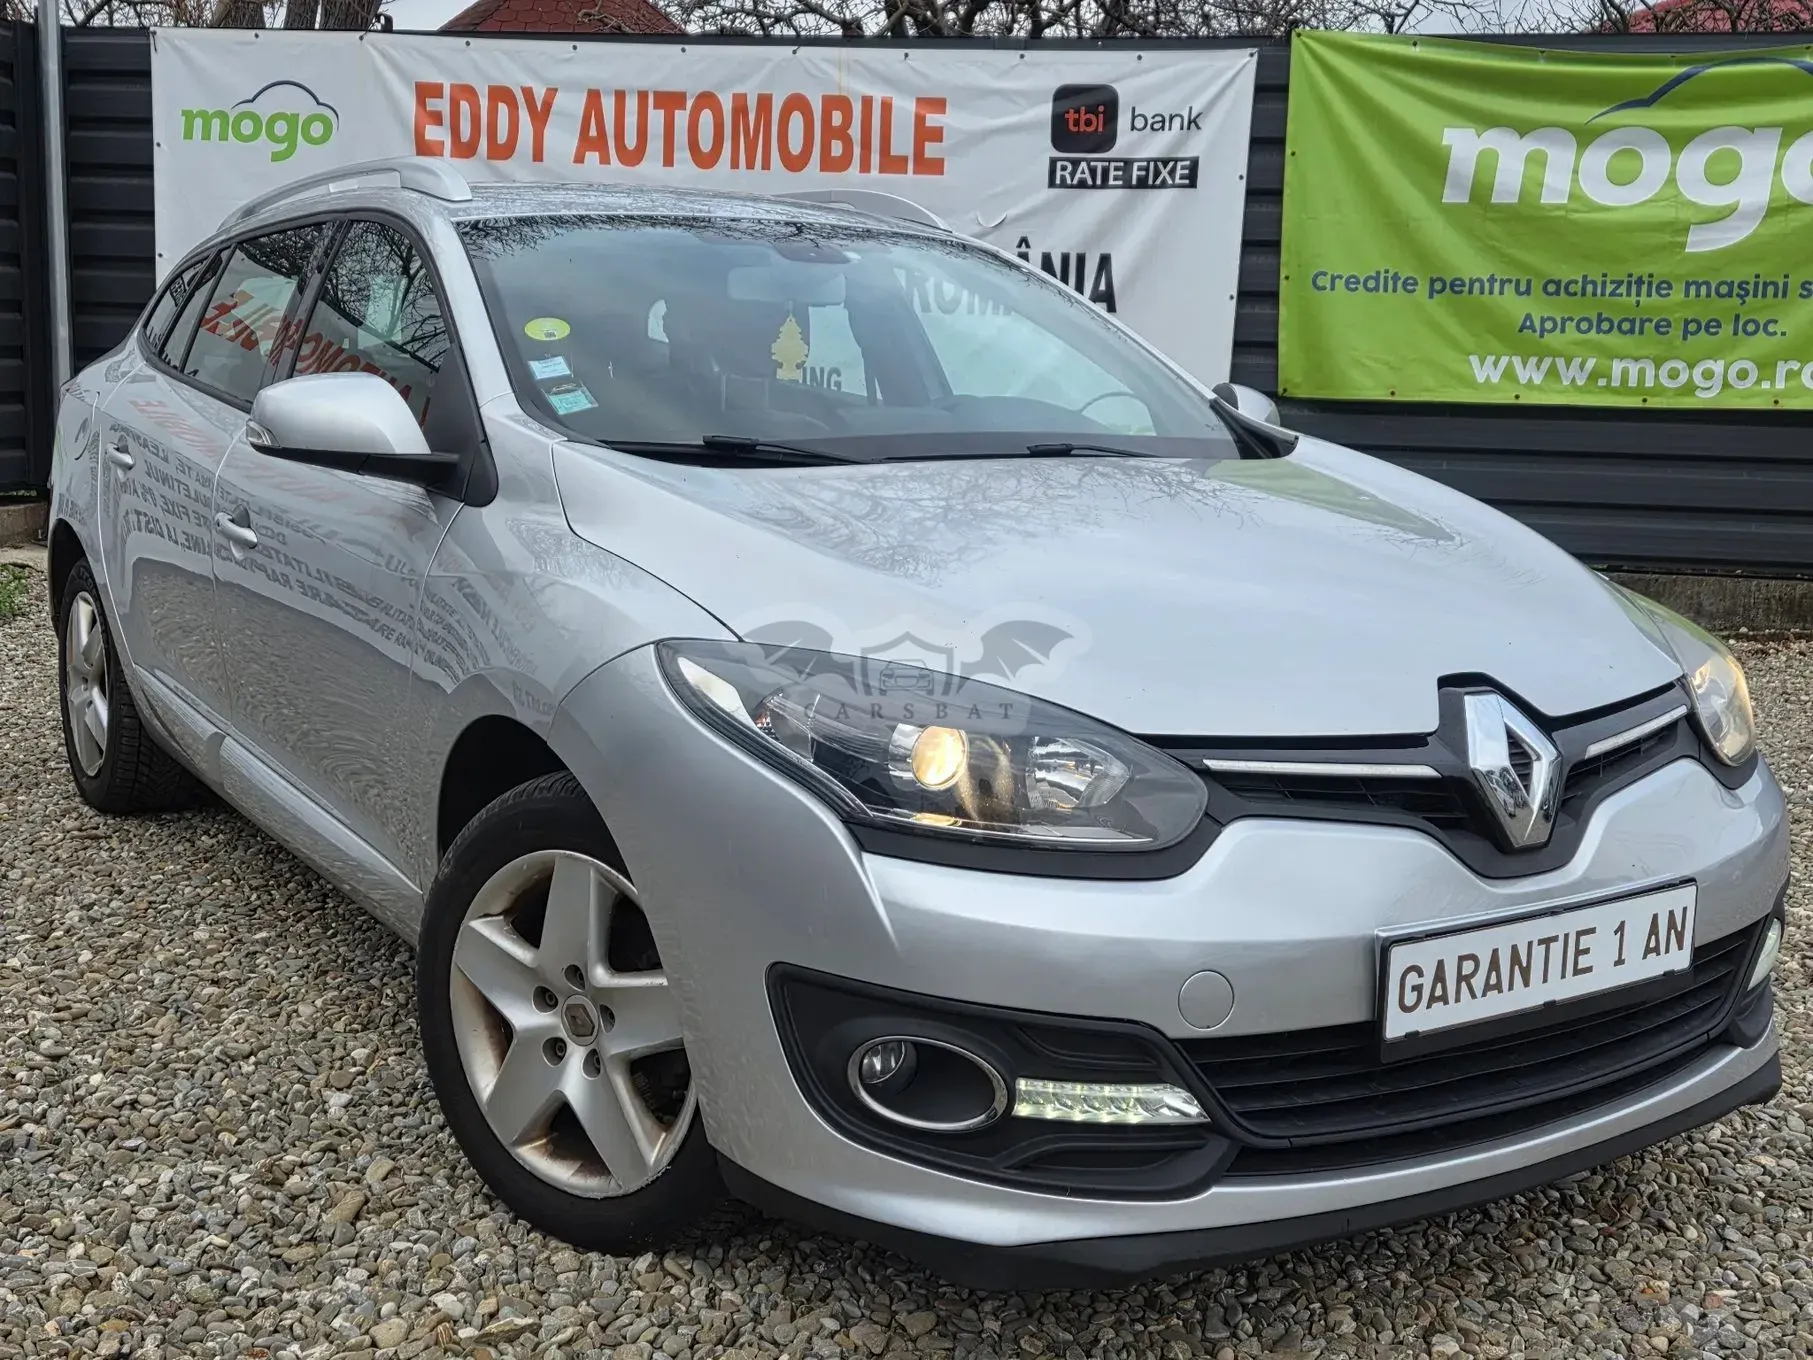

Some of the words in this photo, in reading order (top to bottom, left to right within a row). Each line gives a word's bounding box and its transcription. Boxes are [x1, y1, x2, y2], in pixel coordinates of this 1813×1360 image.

[414, 80, 559, 163] EDDY
[572, 88, 947, 176] AUTOMOBILE
[1065, 105, 1104, 133] tbi
[1130, 105, 1203, 132] bank
[181, 108, 333, 162] mogo
[1055, 160, 1125, 186] RATE
[1131, 160, 1191, 186] FIXE
[1311, 268, 1419, 293] Credite
[1428, 273, 1532, 299] pentru
[1518, 312, 1673, 340] Aprobare
[1682, 316, 1722, 341] pe
[1732, 313, 1787, 337] loc.
[1398, 926, 1597, 1014] GARANTIE
[1613, 920, 1626, 967] 1
[1642, 906, 1688, 960] AN
